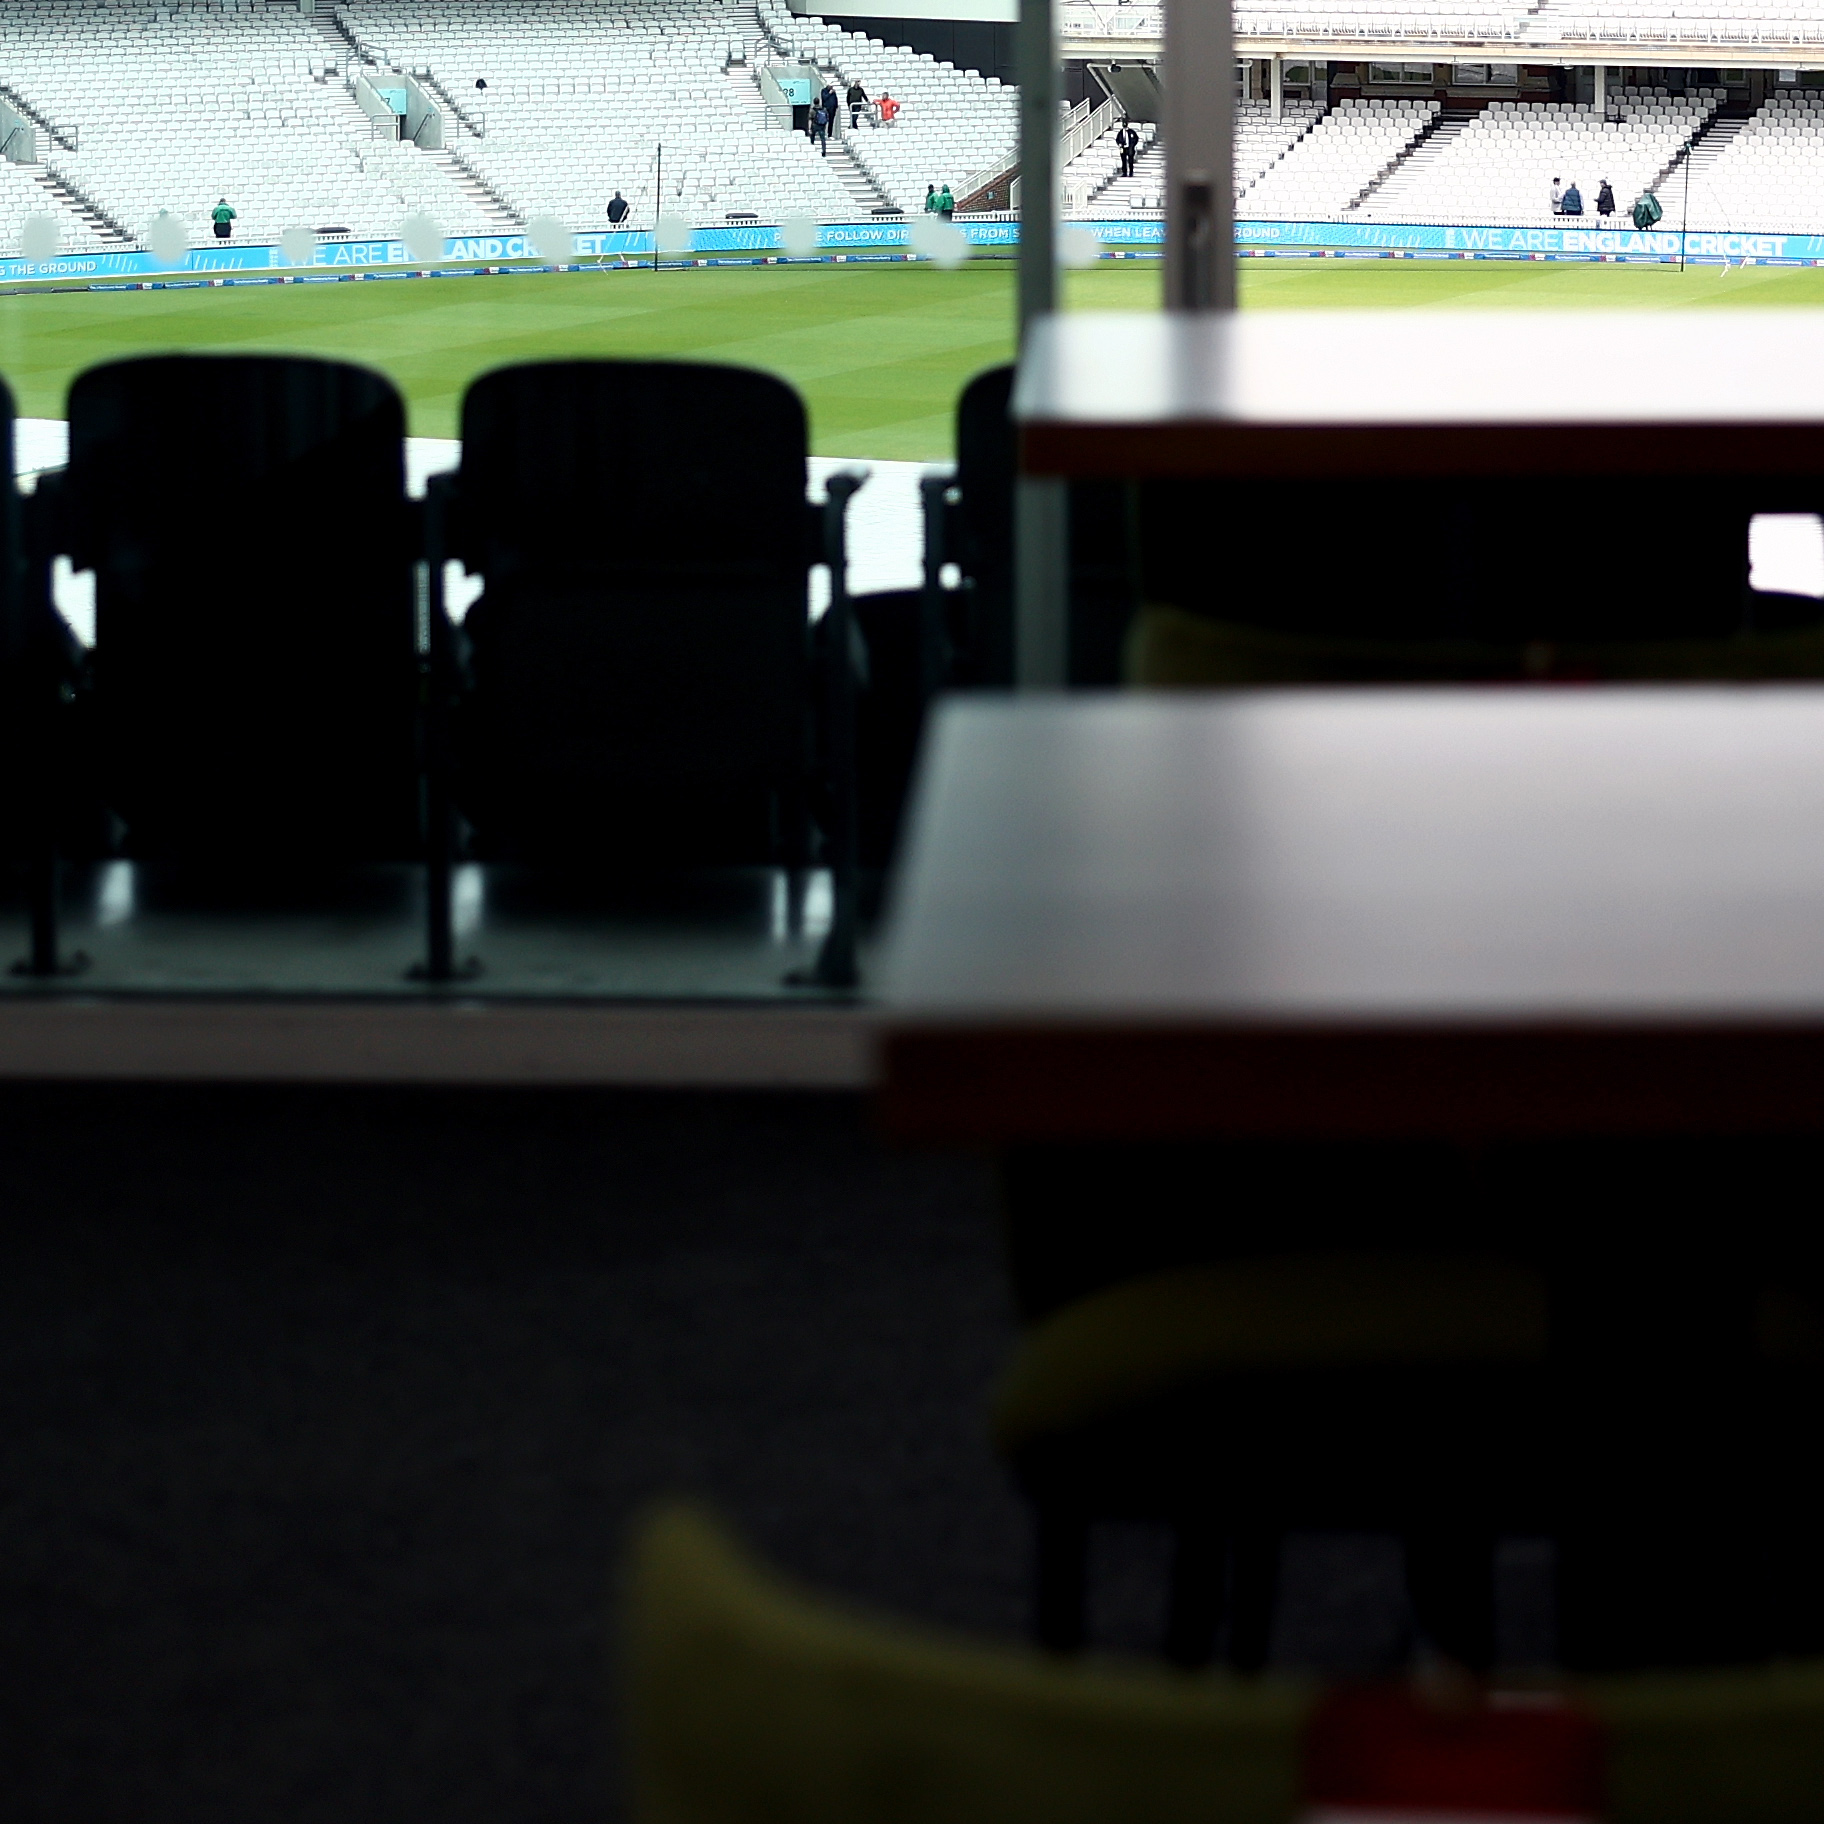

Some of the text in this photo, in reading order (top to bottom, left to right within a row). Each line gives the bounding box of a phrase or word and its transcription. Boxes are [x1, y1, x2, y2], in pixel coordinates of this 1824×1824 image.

[827, 231, 883, 242] FOLLOW
[971, 228, 1008, 239] FROM
[1091, 227, 1131, 238] WHEN
[1234, 227, 1280, 239] ROUND
[1462, 229, 1788, 257] WE ARE ENGLAND CRICKET
[334, 243, 383, 265] ARE
[9, 263, 36, 276] THE
[39, 260, 98, 275] GROUND
